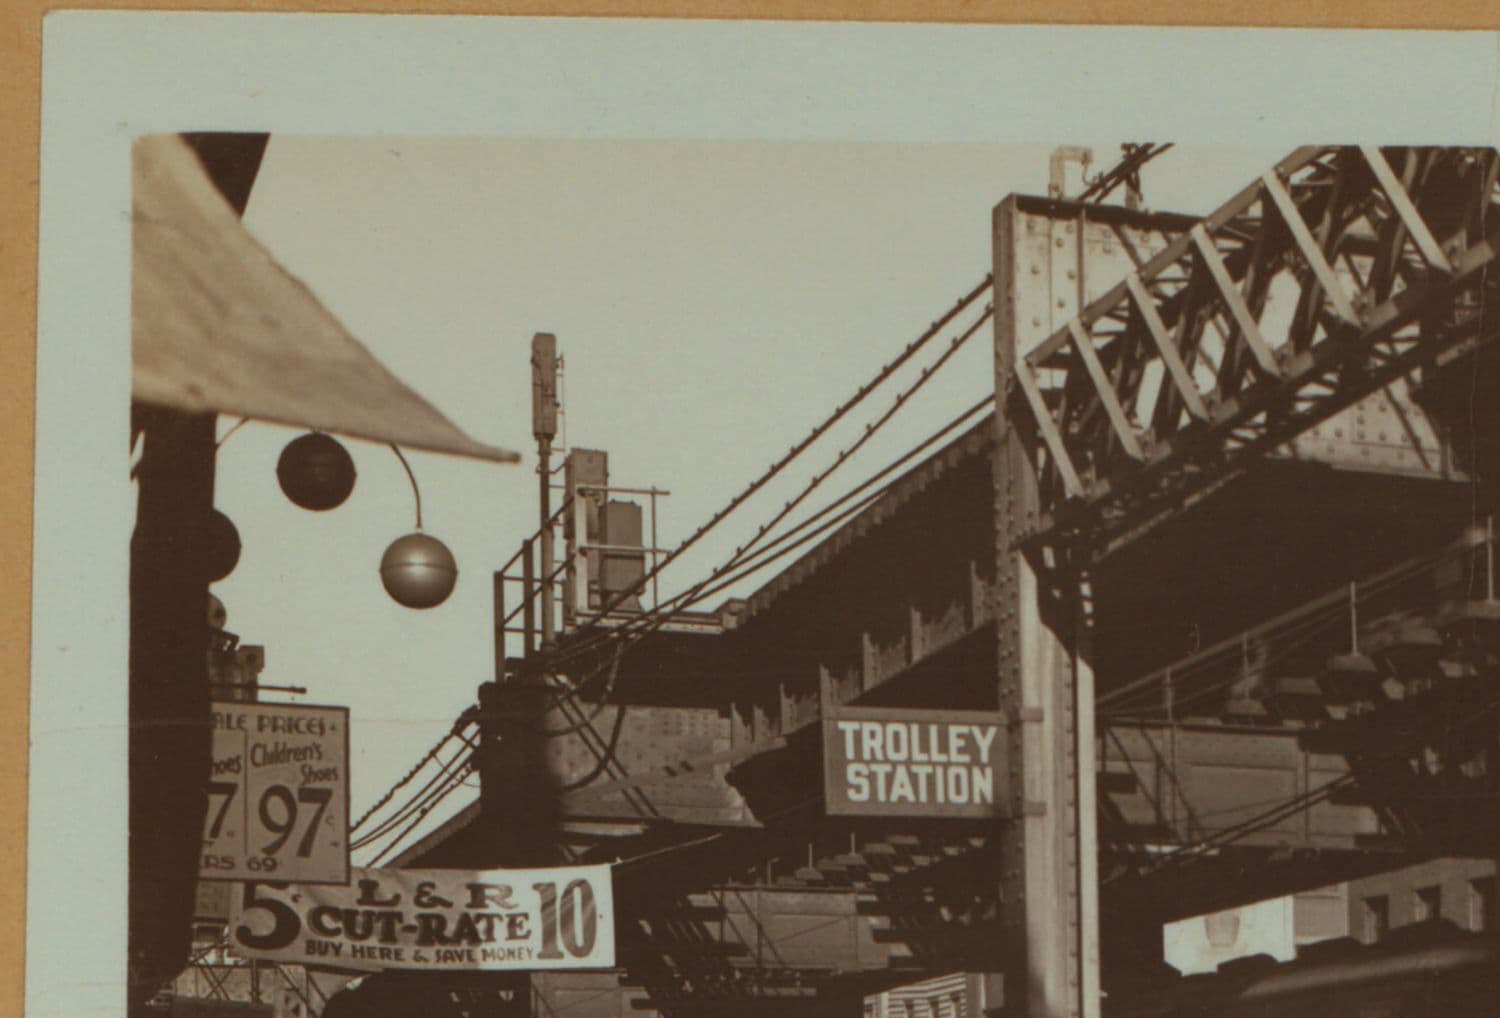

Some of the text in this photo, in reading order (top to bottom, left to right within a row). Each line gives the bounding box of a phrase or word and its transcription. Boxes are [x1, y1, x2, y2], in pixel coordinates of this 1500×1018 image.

[210, 712, 248, 731] ALE
[251, 741, 324, 769] Children's
[838, 721, 997, 764] TROLLEY
[300, 763, 339, 786] Shoes
[846, 763, 994, 804] STATION
[201, 783, 239, 838] 7
[203, 855, 278, 872] RS 69
[356, 879, 521, 909] L & R
[306, 906, 533, 946] CUT-RATE
[534, 878, 599, 960] 10
[305, 939, 342, 957] BUY
[351, 944, 405, 962] HERE
[435, 948, 476, 964] SAVE
[481, 945, 535, 963] MONEY
